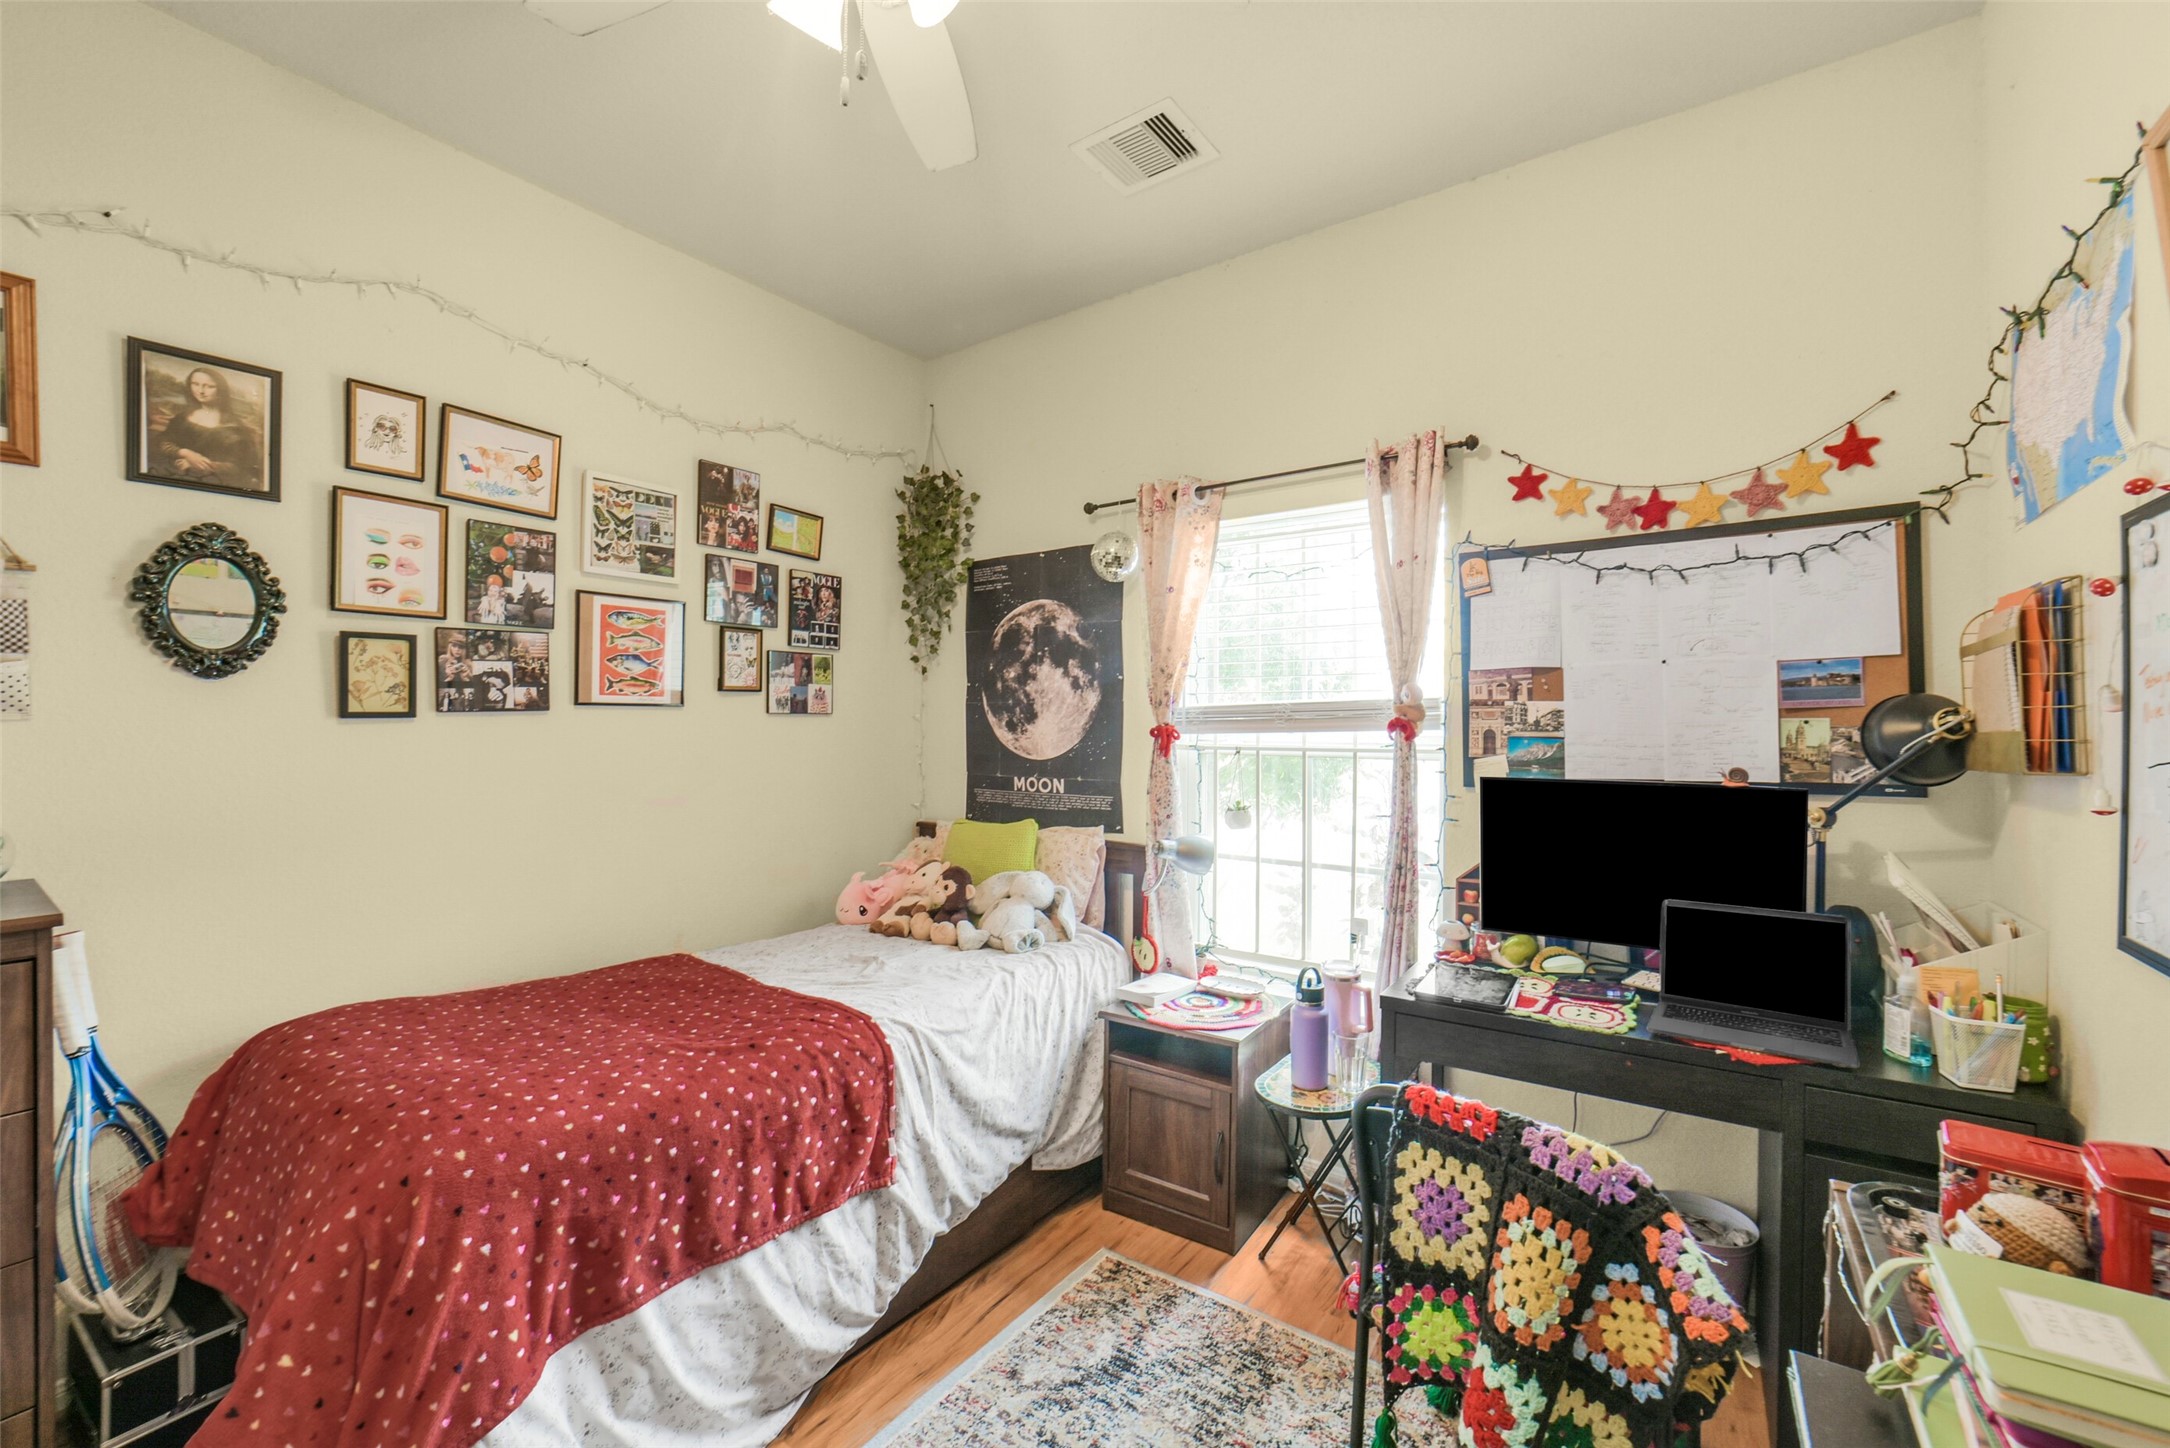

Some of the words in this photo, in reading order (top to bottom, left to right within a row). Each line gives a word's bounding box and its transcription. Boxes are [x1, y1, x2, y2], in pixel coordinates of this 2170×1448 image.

[701, 505, 729, 518] VOGUE
[811, 574, 840, 588] VOGUE
[1013, 776, 1065, 794] MOON
